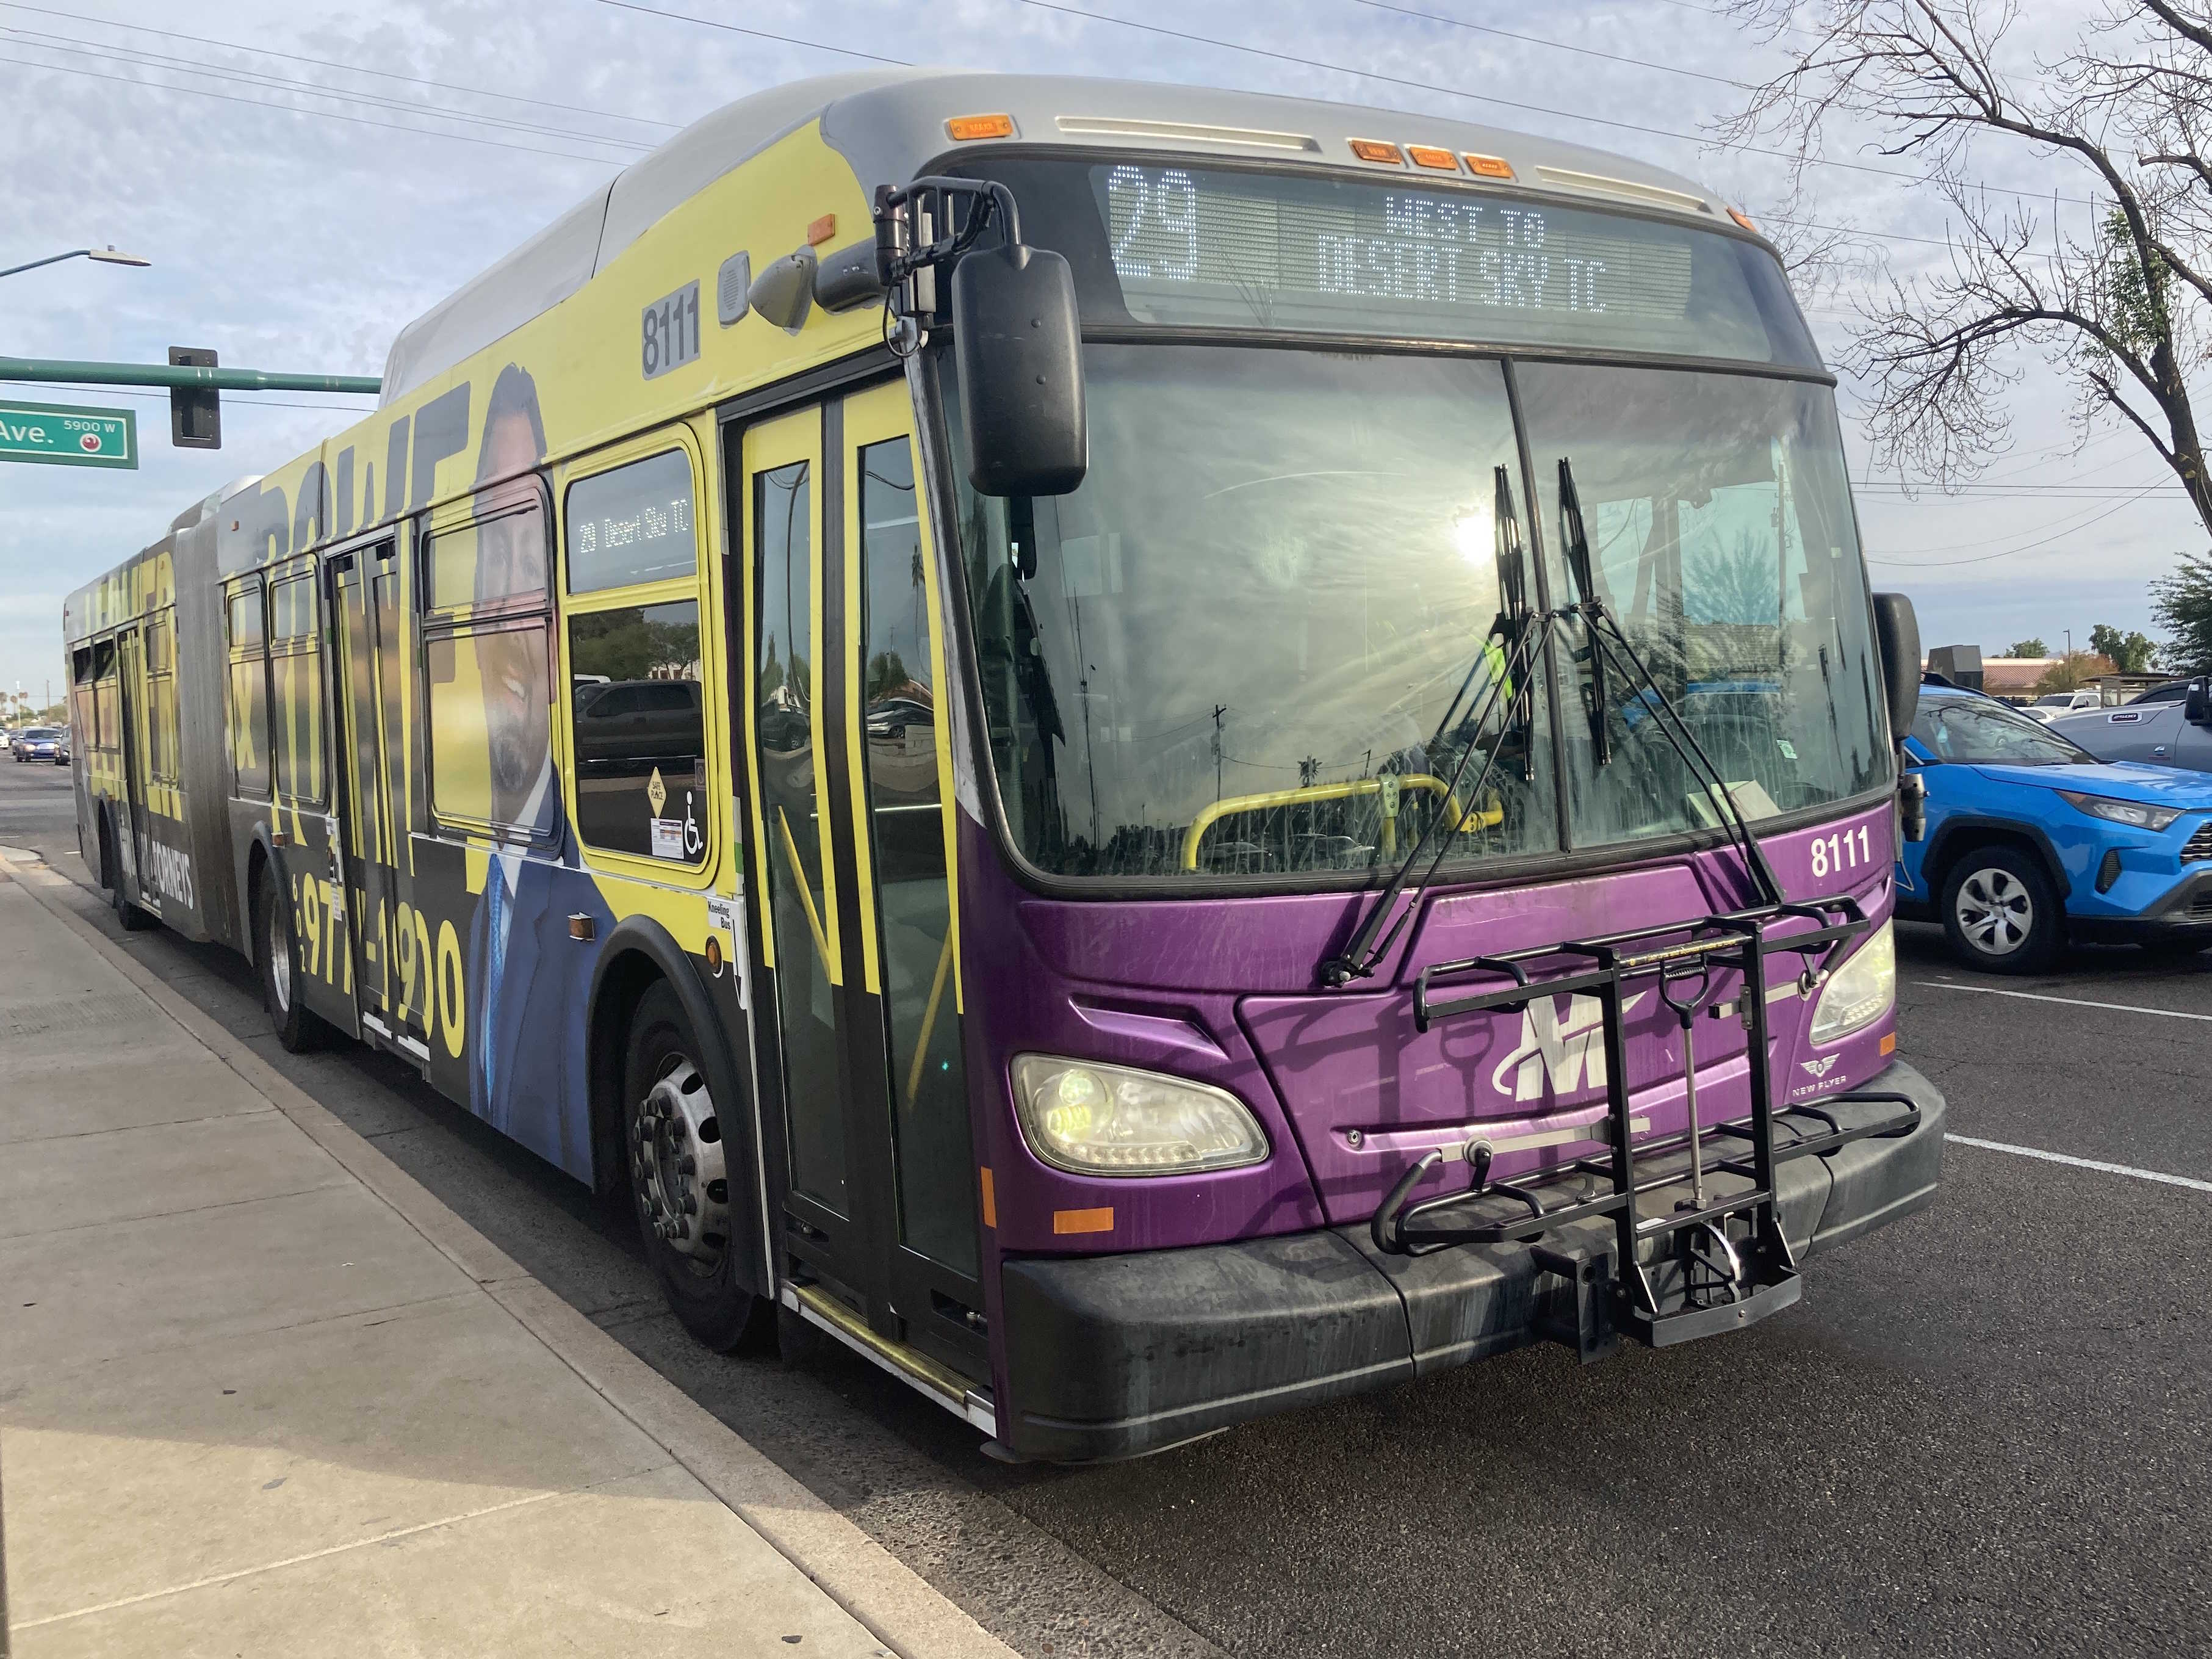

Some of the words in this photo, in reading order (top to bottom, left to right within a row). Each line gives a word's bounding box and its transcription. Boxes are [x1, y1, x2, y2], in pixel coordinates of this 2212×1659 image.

[1108, 165, 1198, 280] 29
[1386, 196, 1483, 243] WEST
[1500, 209, 1545, 248] TO
[1318, 234, 1463, 302] DESERT
[1480, 250, 1548, 308] SKY
[1563, 258, 1607, 313] TC
[643, 286, 699, 375] 8111
[63, 419, 101, 432] 5900
[104, 422, 116, 433] W
[605, 515, 642, 548] Desert
[644, 507, 668, 538] Sky
[671, 498, 689, 533] TC
[1810, 825, 1870, 877] 8111
[708, 900, 730, 919] Kneeling
[721, 917, 731, 930] Bus
[1792, 1084, 1816, 1097] NEW
[1818, 1075, 1846, 1090] FLYER
